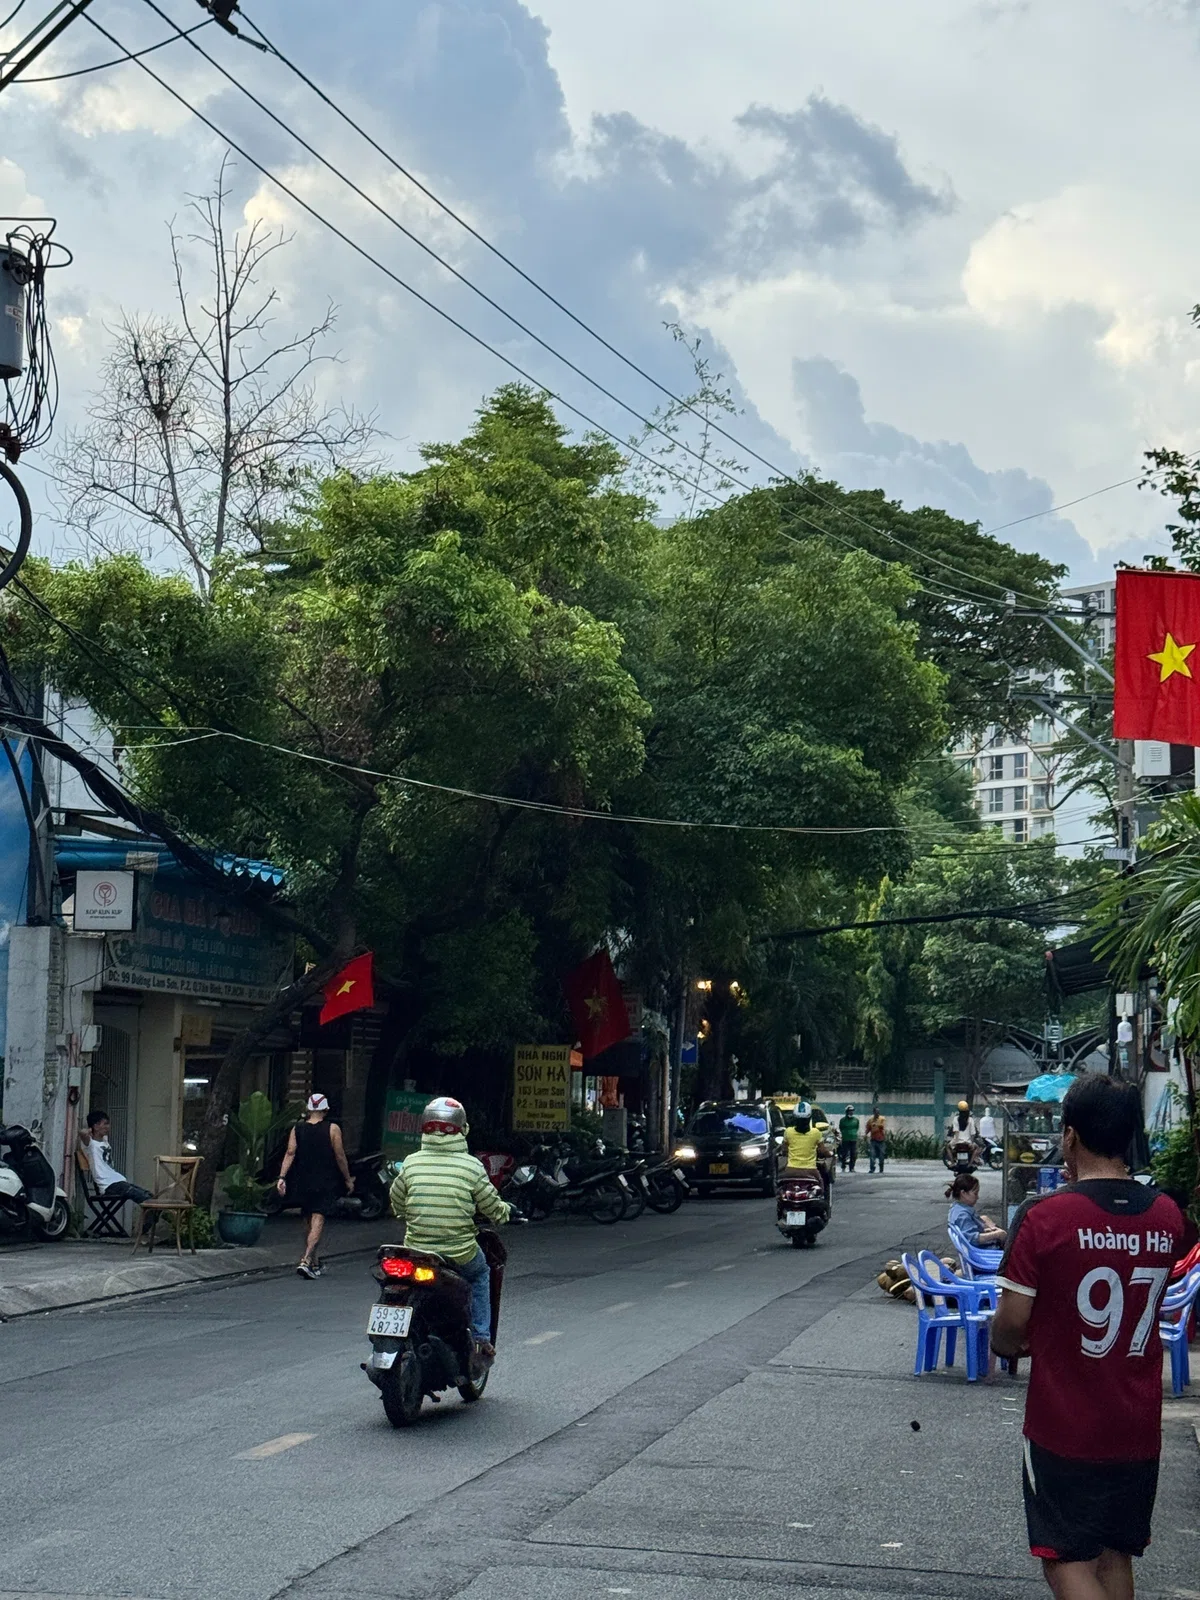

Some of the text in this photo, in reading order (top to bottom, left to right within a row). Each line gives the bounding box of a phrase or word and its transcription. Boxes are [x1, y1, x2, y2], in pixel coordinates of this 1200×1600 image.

[121, 971, 131, 984] 99
[1077, 1225, 1140, 1256] Hoàng
[376, 1307, 406, 1321] 59-S3
[1076, 1266, 1171, 1359] 97
